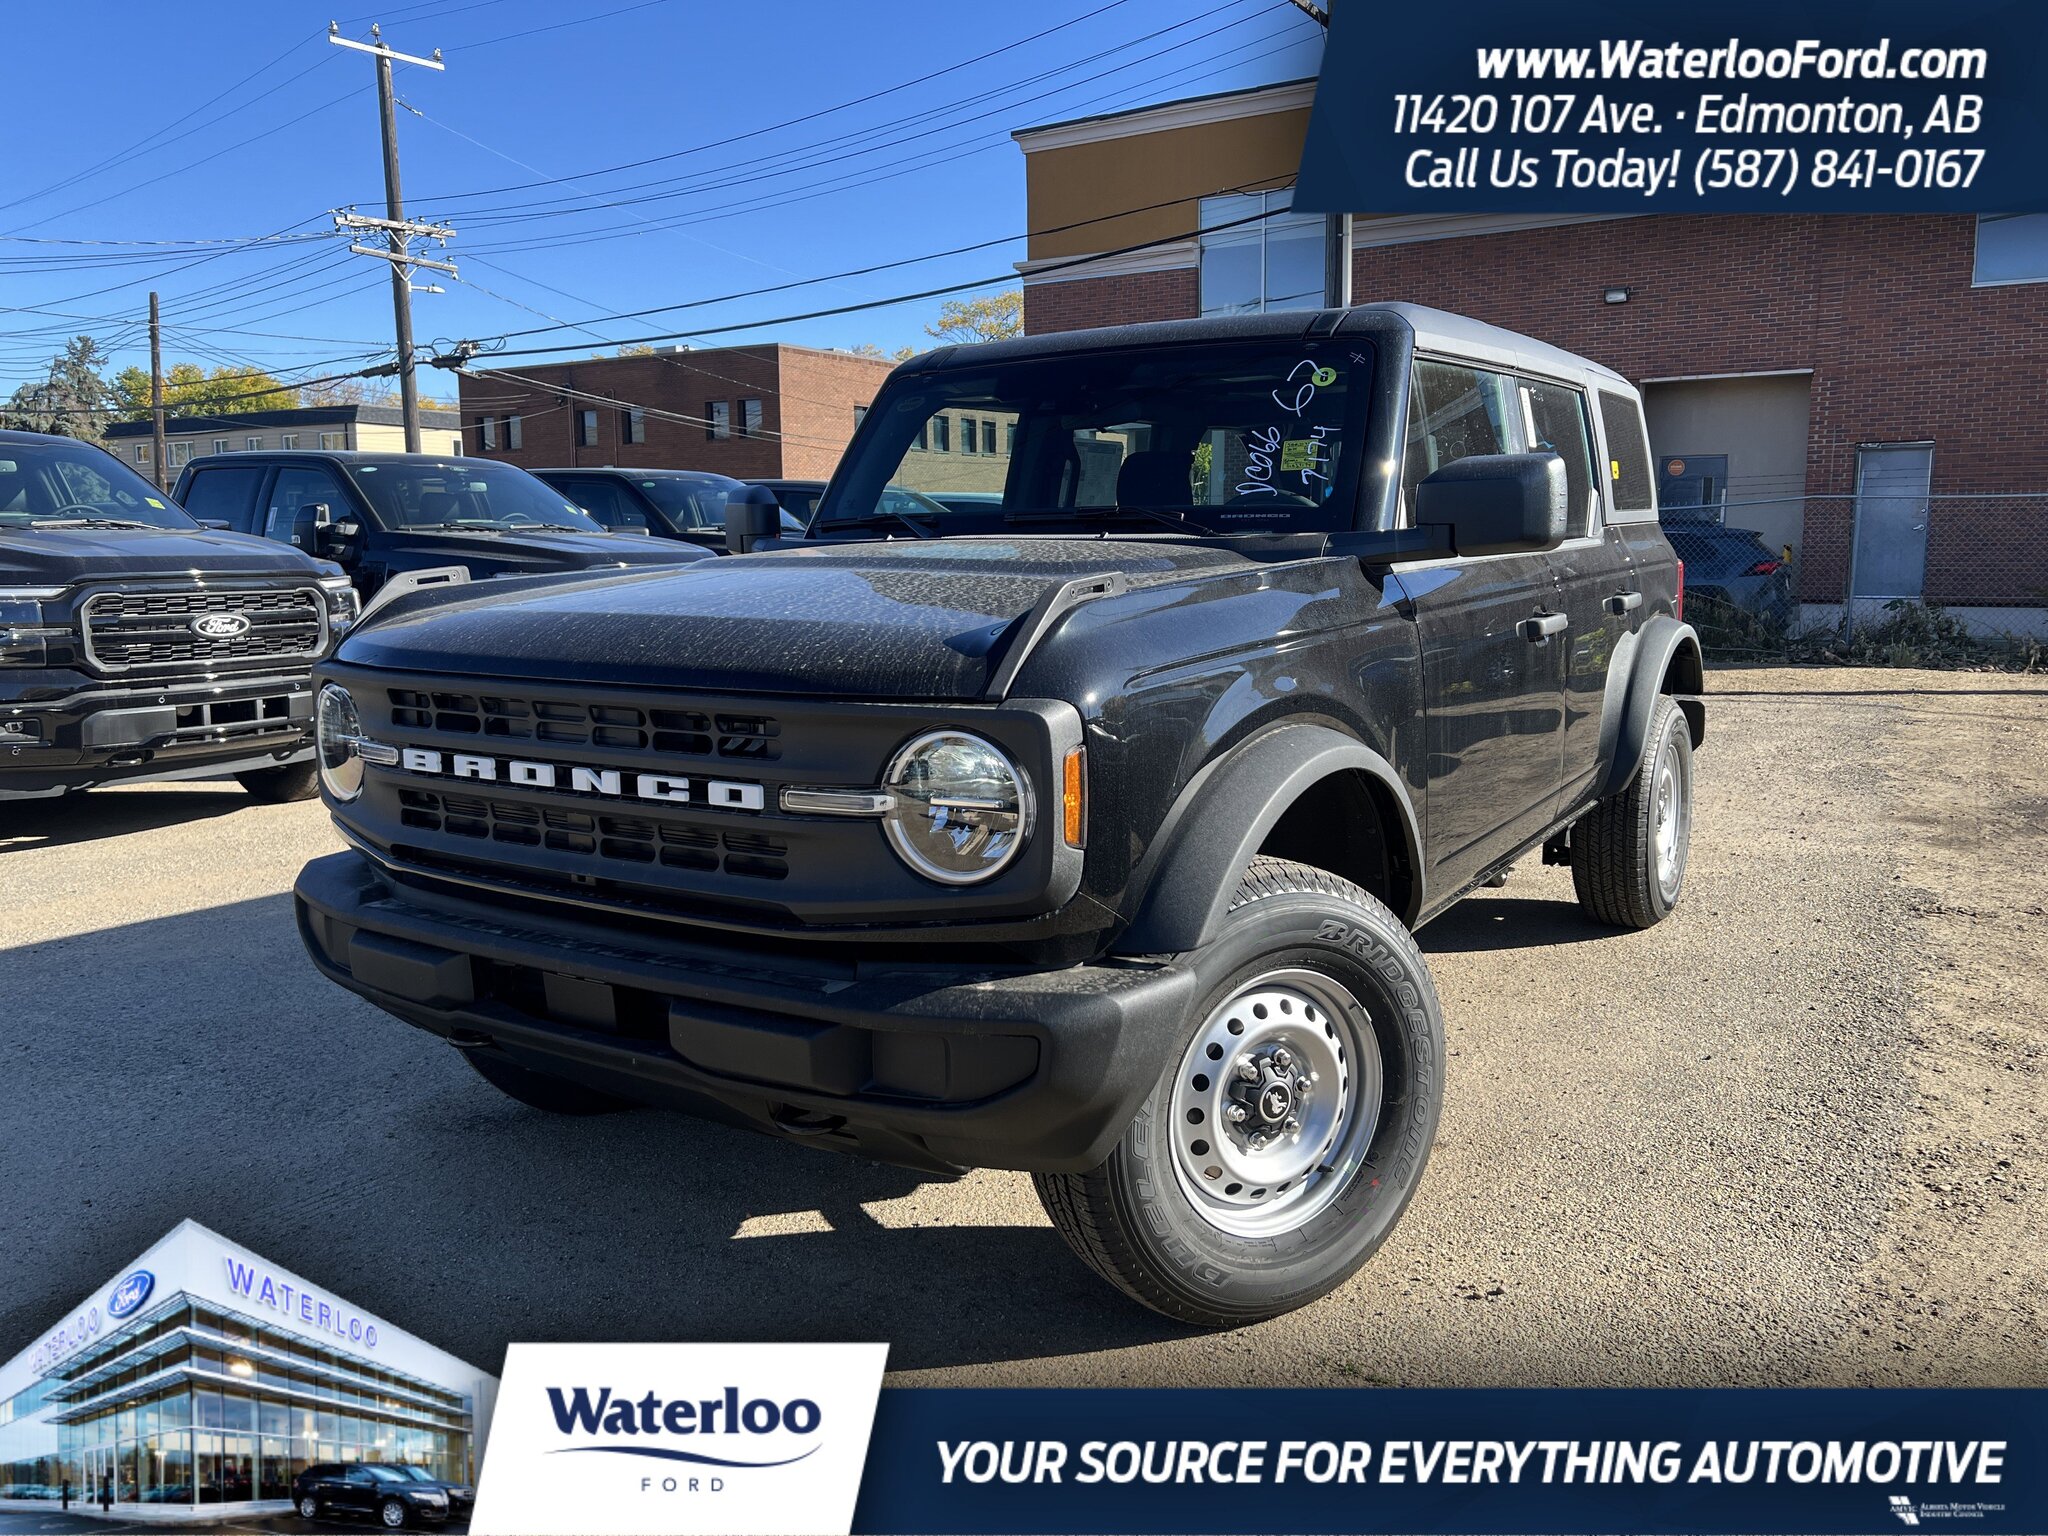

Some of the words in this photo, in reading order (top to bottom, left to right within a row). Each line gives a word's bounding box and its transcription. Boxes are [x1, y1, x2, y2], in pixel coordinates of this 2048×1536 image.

[206, 617, 240, 633] Ford
[402, 747, 765, 810] BRONCO
[1312, 919, 1433, 1190] BRIDGESTONE
